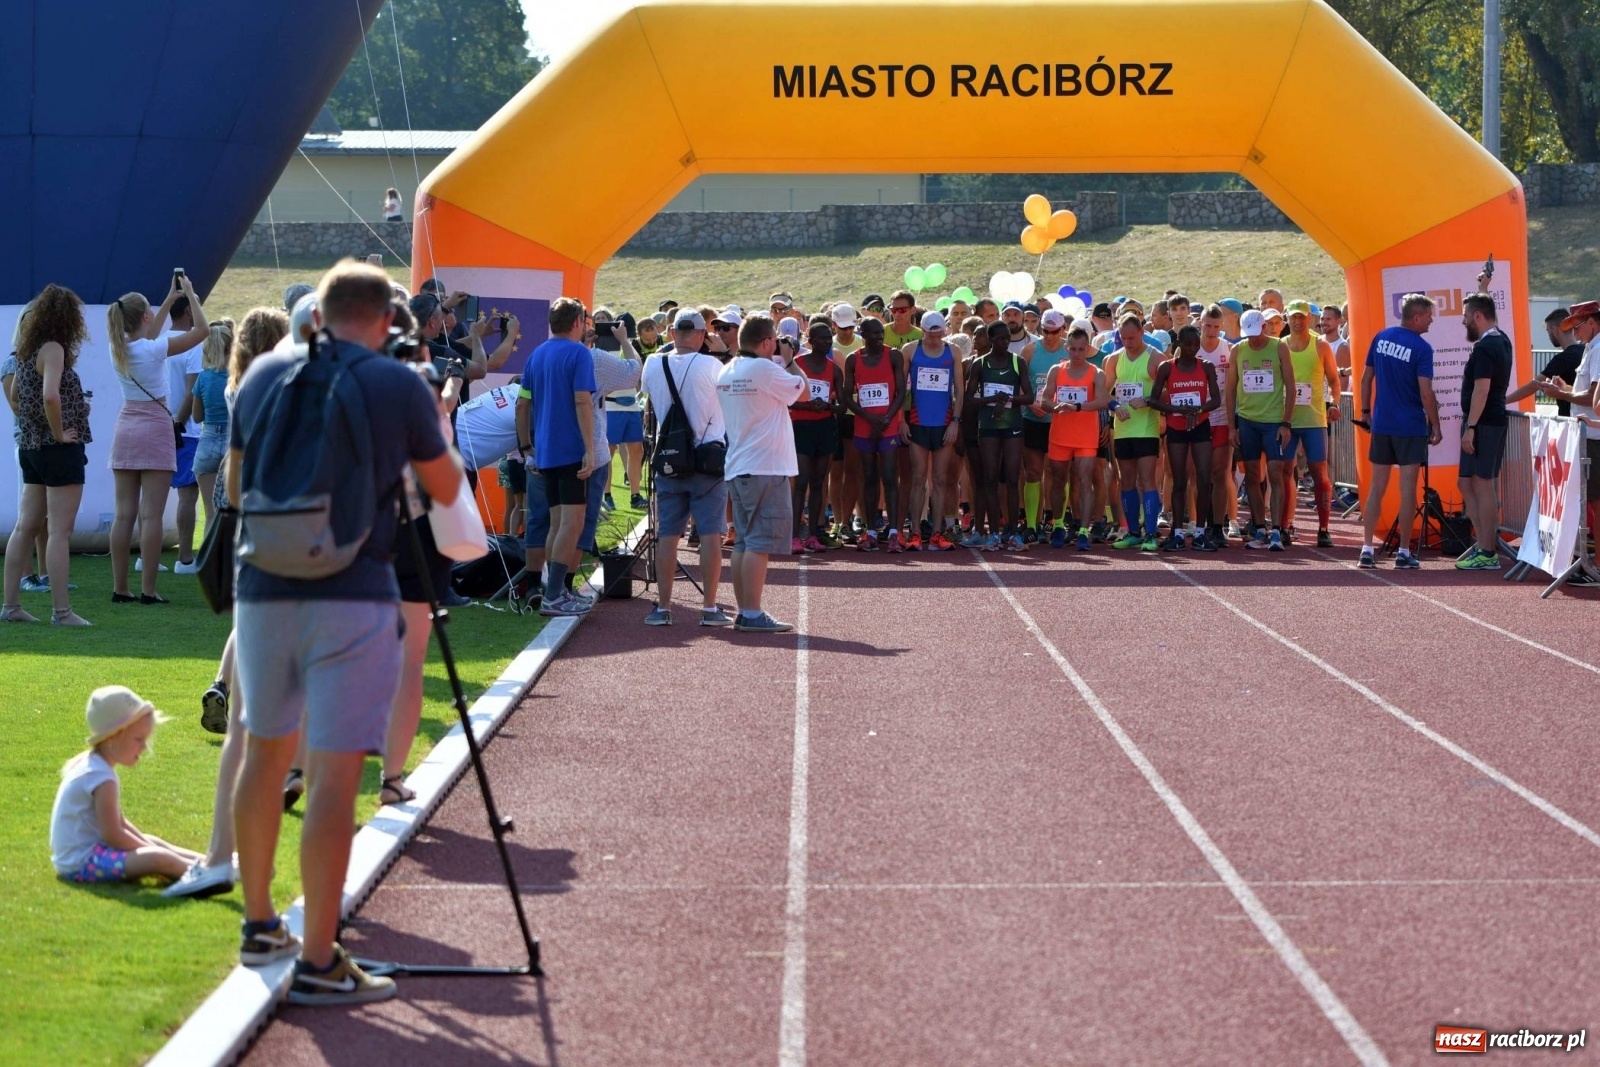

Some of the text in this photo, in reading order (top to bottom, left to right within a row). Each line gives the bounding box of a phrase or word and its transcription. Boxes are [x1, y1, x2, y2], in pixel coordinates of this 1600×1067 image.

[773, 56, 1173, 98] MIASTO RACIBÓRZ
[1376, 339, 1412, 363] SĘDZIA
[929, 374, 939, 382] 58
[1255, 376, 1264, 384] 12
[812, 385, 821, 393] 39
[1173, 380, 1204, 389] newline
[868, 389, 882, 398] 130
[1123, 388, 1136, 396] 287
[1069, 393, 1078, 402] 61
